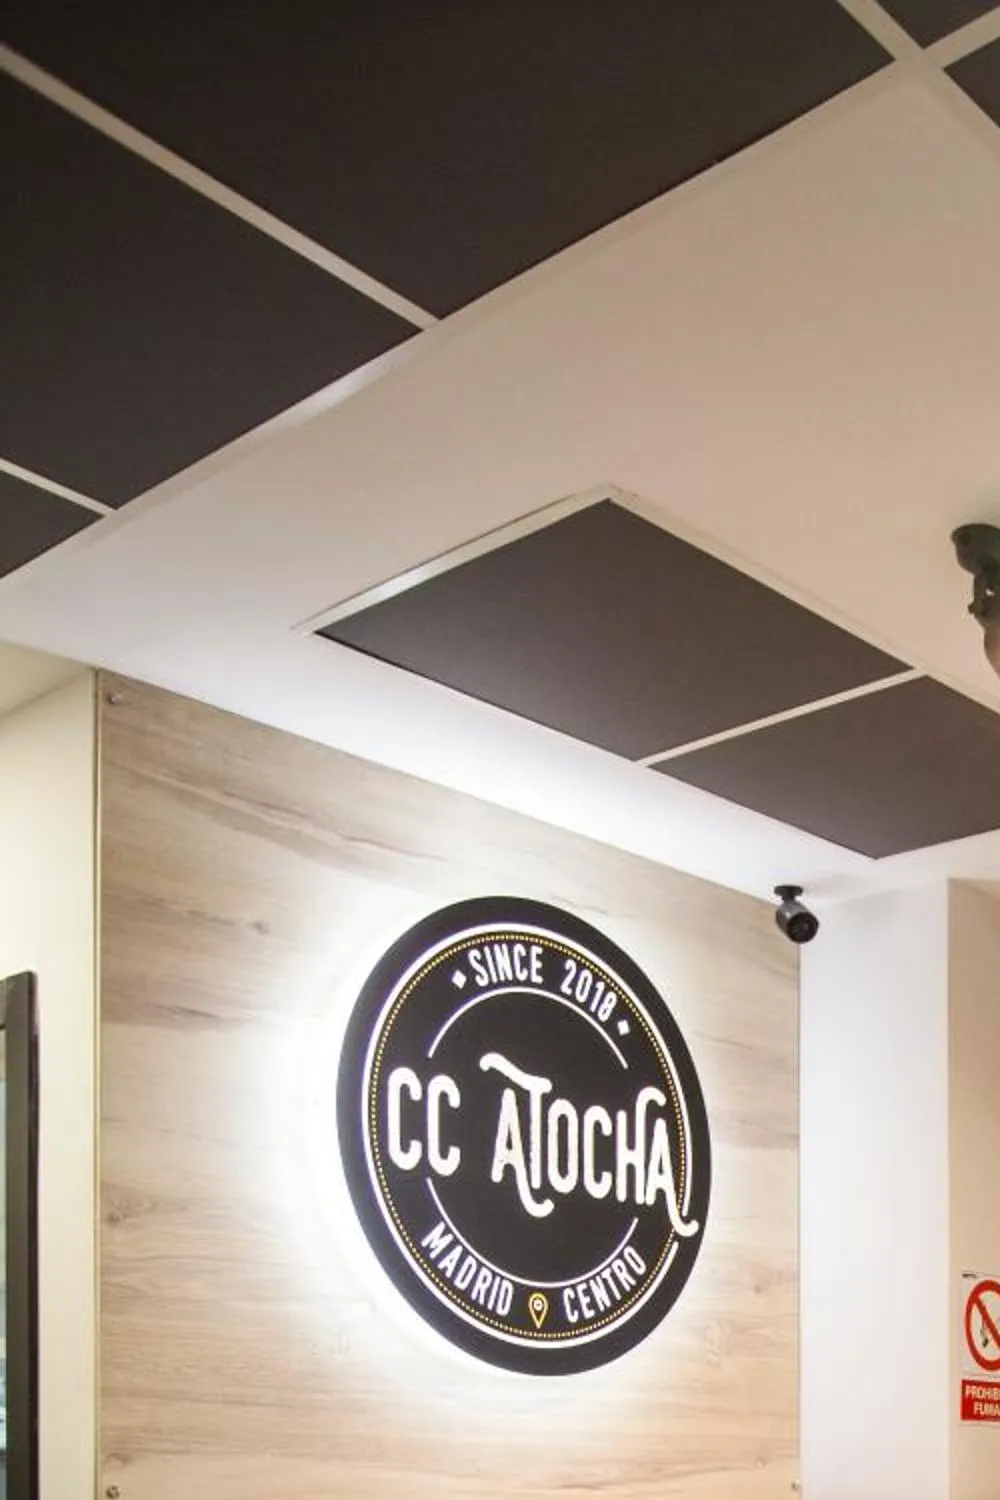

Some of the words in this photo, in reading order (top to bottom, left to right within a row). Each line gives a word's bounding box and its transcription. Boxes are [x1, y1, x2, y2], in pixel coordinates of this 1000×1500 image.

[467, 943, 544, 988] SINCE
[560, 958, 619, 1023] 2018
[387, 1066, 462, 1177] CC
[479, 1052, 699, 1237] ATOCHA
[421, 1220, 515, 1317] MADRID
[562, 1246, 648, 1324] CENTRO
